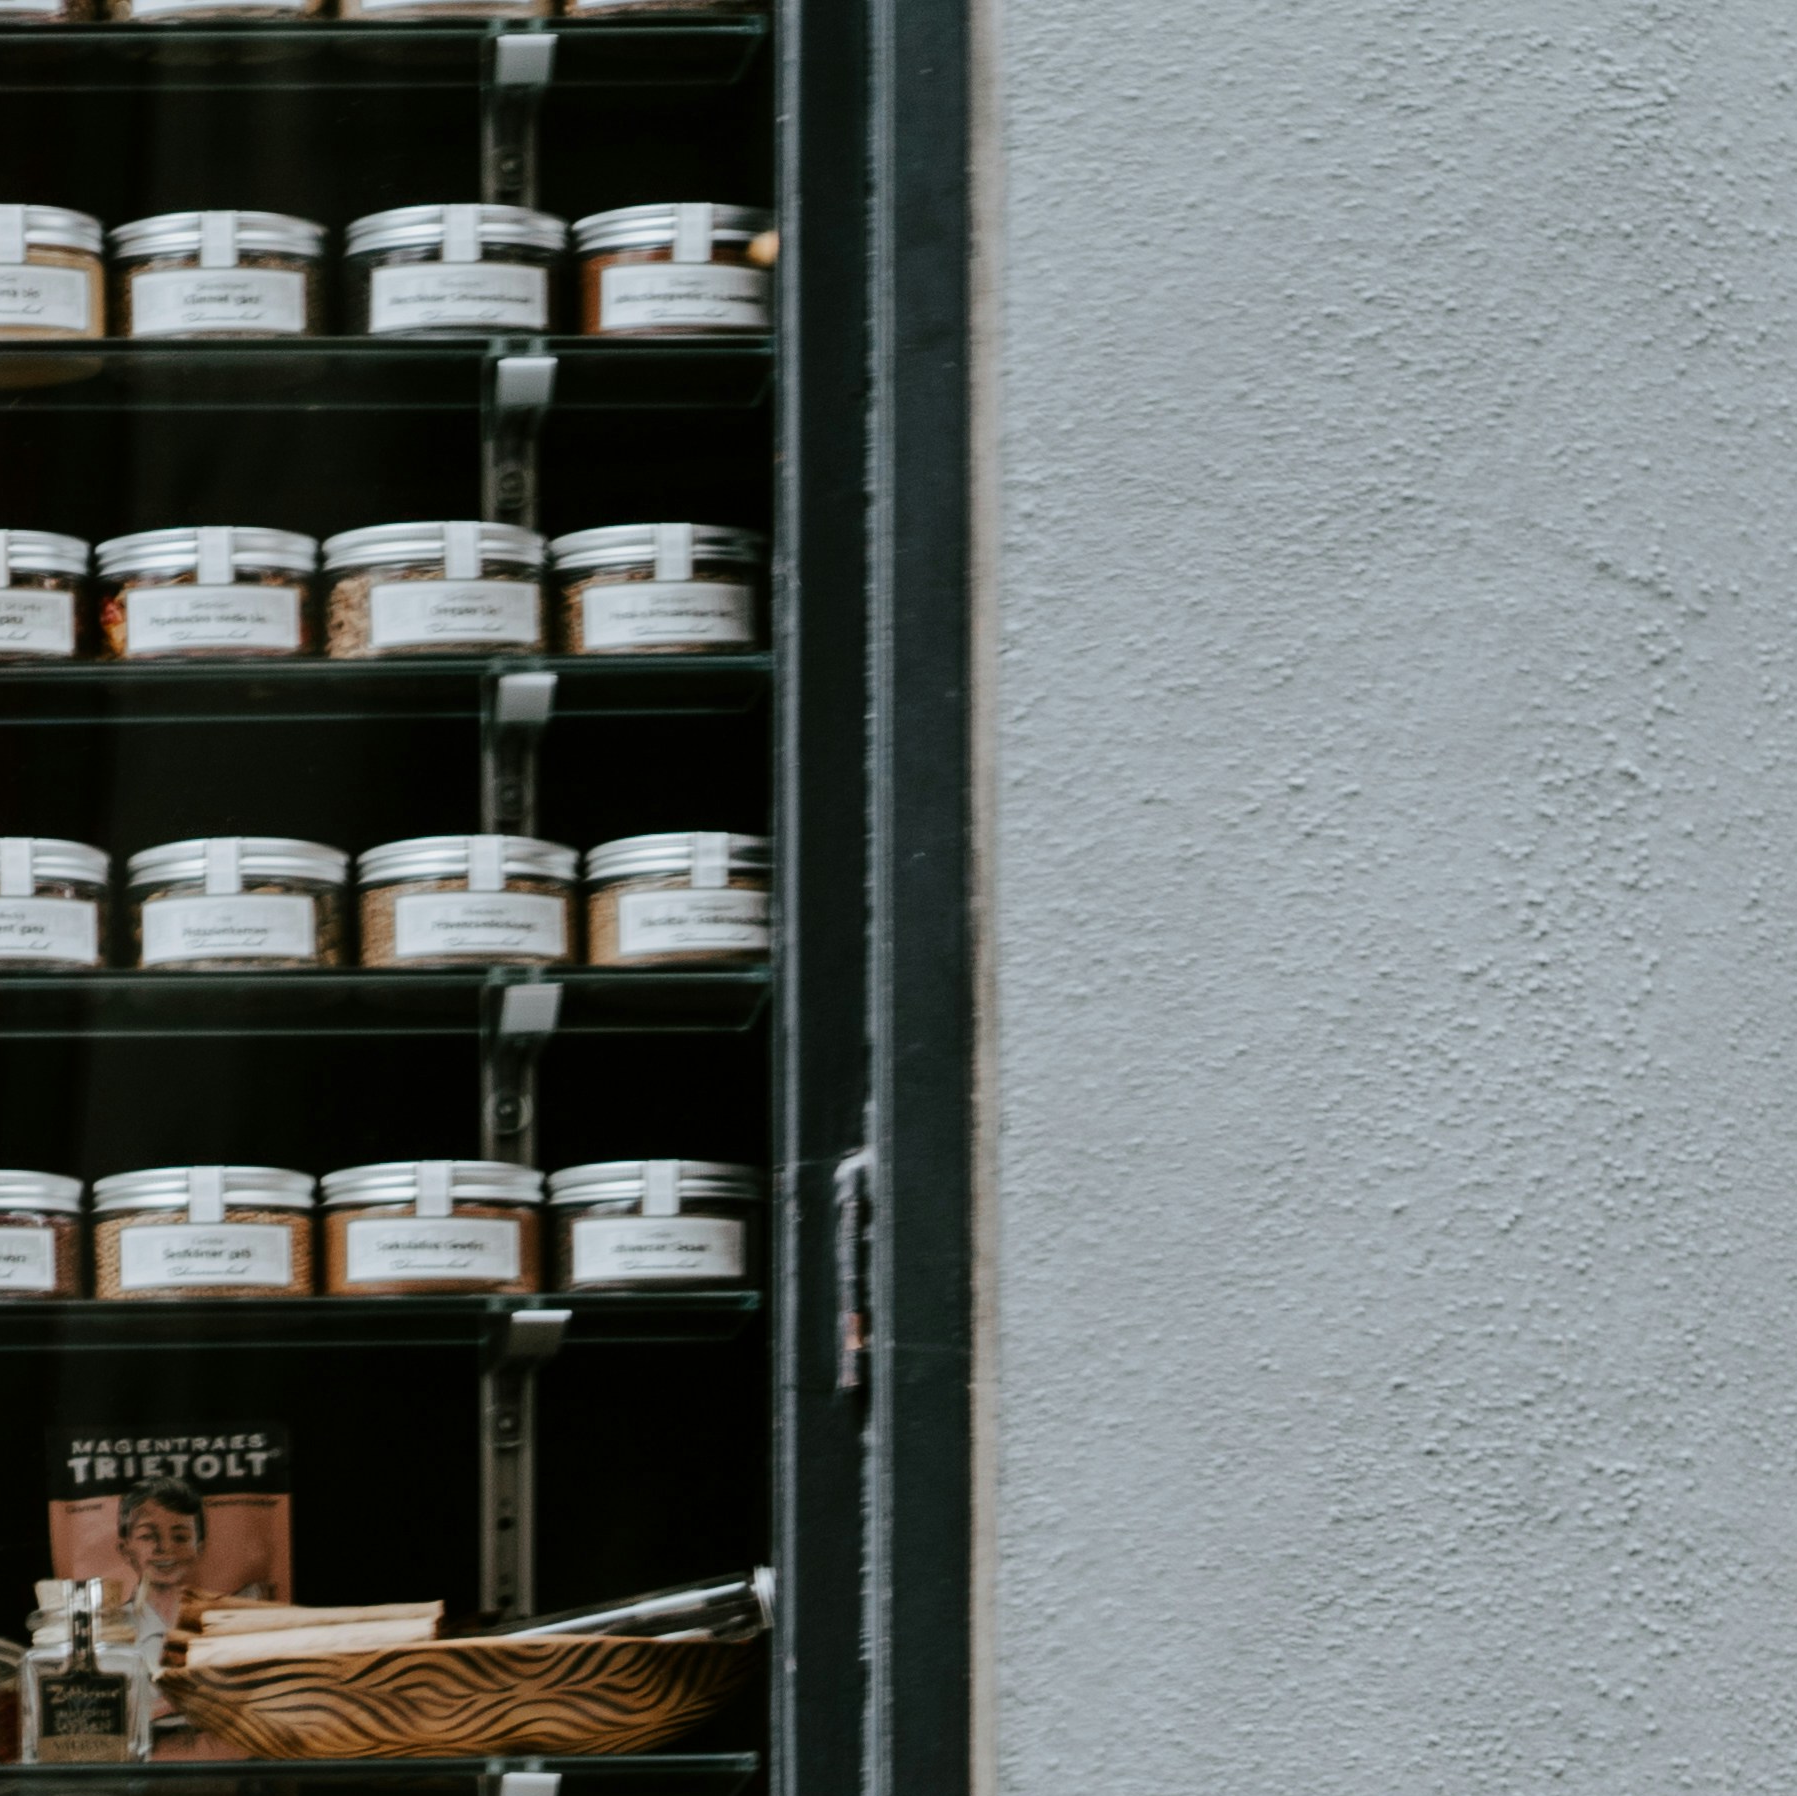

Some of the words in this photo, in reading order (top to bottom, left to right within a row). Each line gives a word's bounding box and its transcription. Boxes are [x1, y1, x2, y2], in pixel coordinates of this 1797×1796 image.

[19, 923, 45, 935] ganz
[163, 1248, 223, 1260] Senfkörner
[72, 1433, 266, 1455] MAGENTRAES
[68, 1452, 268, 1483] TRIETOLT
